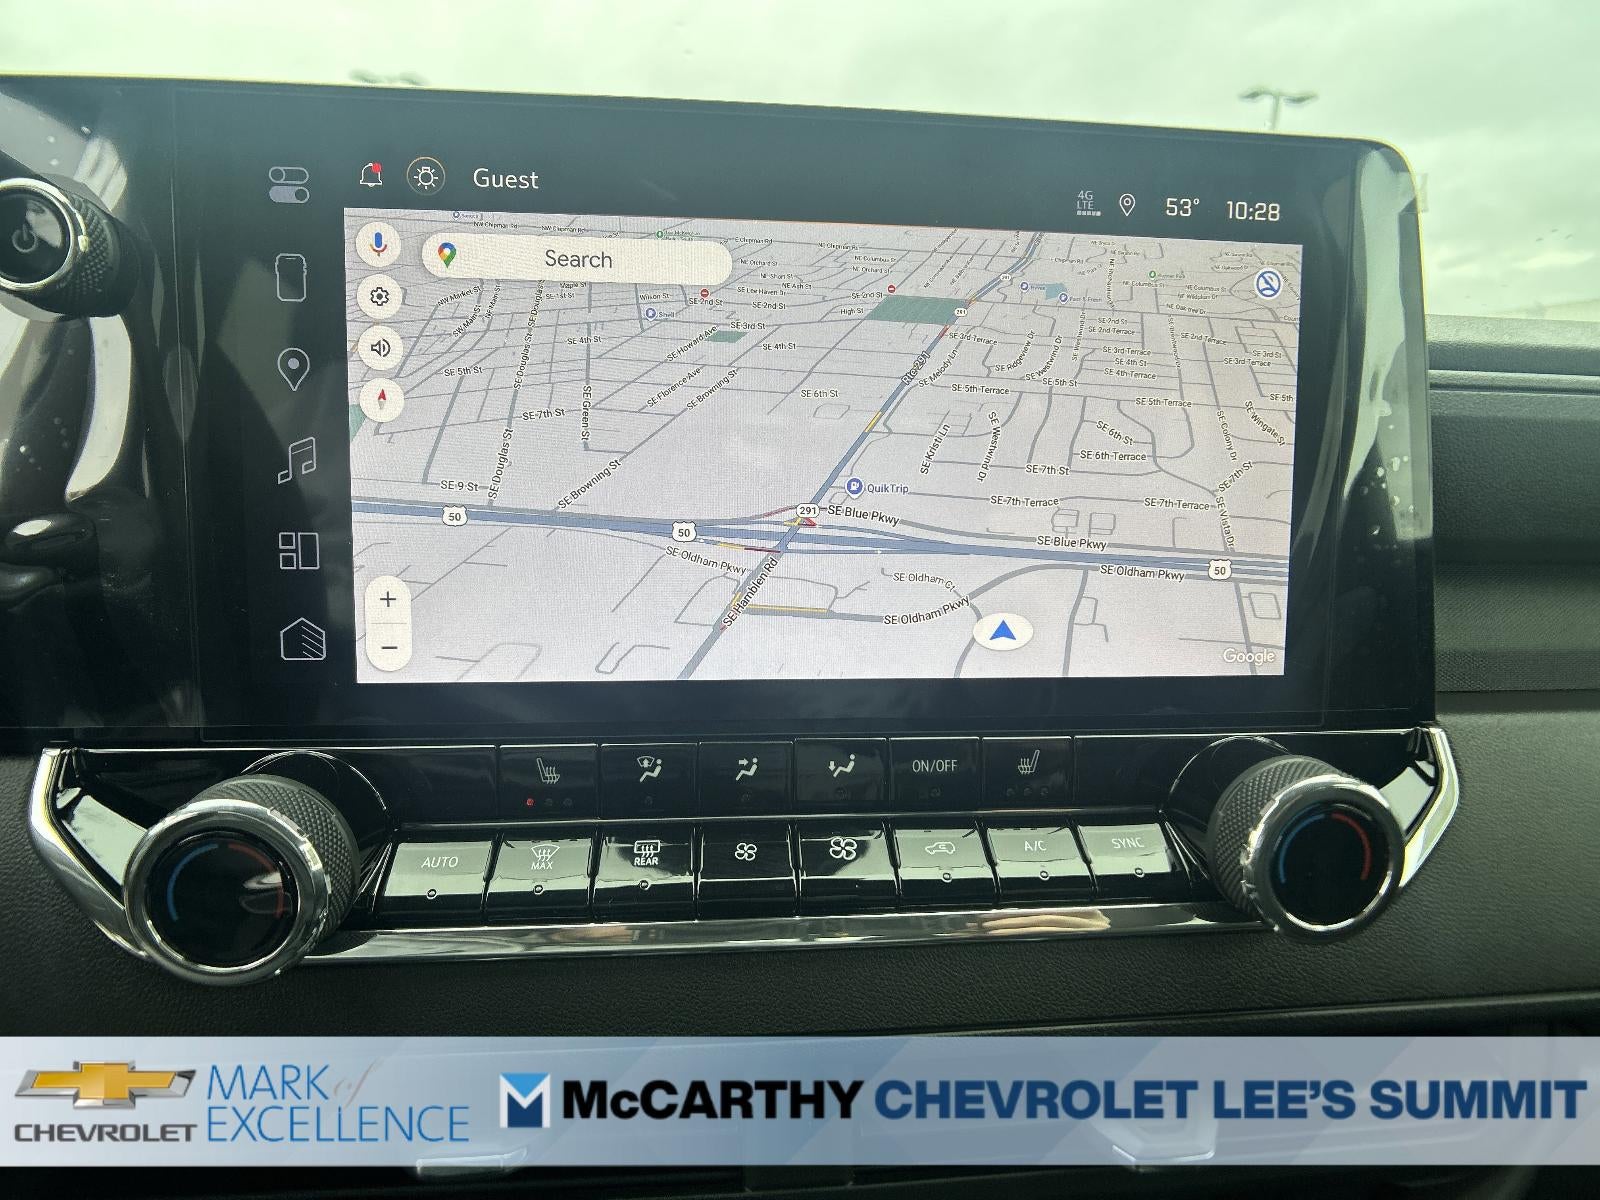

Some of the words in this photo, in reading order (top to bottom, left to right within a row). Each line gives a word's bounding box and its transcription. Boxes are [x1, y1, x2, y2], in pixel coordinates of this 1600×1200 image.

[473, 168, 539, 189] Guest
[1078, 191, 1093, 199] 4G
[1077, 201, 1093, 209] LTE
[1166, 198, 1199, 216] 53°
[1227, 201, 1280, 221] 10:28
[545, 249, 613, 269] Search
[525, 332, 533, 342] St
[667, 351, 678, 361] SE
[677, 335, 703, 355] Howard
[703, 325, 717, 338] Ave
[960, 333, 970, 341] 3rd
[972, 335, 997, 345] Terrace
[1007, 341, 1031, 371] Ridgeview
[1027, 330, 1035, 340] Dr
[517, 344, 530, 376] Douglas
[1026, 373, 1036, 381] SE
[1036, 344, 1060, 378] Westwind
[1055, 335, 1062, 344] Dr
[473, 366, 482, 374] St
[918, 377, 930, 387] SE
[930, 357, 953, 382] Melody
[951, 349, 958, 359] Ln
[1130, 370, 1156, 379] Terrace
[514, 377, 523, 389] SE
[647, 397, 658, 407] SE
[657, 378, 687, 400] Florence
[687, 368, 701, 380] Ave
[686, 399, 697, 410] SE
[697, 376, 729, 402] Browning
[728, 369, 737, 379] St
[952, 384, 962, 392] SE
[964, 385, 977, 393] 5th
[980, 387, 1009, 395] Terrace
[583, 385, 591, 399] SE
[522, 412, 535, 420] SE
[538, 410, 552, 419] 7th
[554, 408, 565, 416] St
[582, 401, 591, 427] Green
[988, 412, 999, 426] SE
[1245, 401, 1255, 414] SE
[1252, 414, 1278, 438] Wingate
[1276, 435, 1285, 446] St
[503, 429, 513, 440] St
[582, 431, 589, 440] St
[1096, 421, 1108, 431] SE
[1108, 428, 1122, 440] 6th
[1122, 435, 1134, 445] St
[1217, 411, 1225, 422] SE
[1221, 422, 1235, 452] Colony
[1230, 451, 1237, 460] Dr
[921, 462, 931, 474] SE
[928, 436, 943, 461] Kristi
[942, 424, 950, 437] Ln
[983, 427, 1000, 470] Westwind
[1080, 451, 1092, 459] SE
[1095, 452, 1110, 460] 6th
[492, 442, 510, 483] Douglas
[977, 472, 986, 482] Dr
[1026, 465, 1038, 473] SE
[1041, 465, 1056, 474] 7th
[1059, 467, 1069, 475] St
[1219, 481, 1230, 492] SE
[1228, 469, 1243, 484] 7th
[1242, 461, 1252, 471] St
[441, 480, 454, 489] SE
[458, 482, 463, 490] 9
[467, 483, 478, 491] St
[558, 497, 571, 509] SE
[571, 467, 611, 499] Browning
[609, 459, 621, 470] St
[867, 484, 908, 495] QuikTrip
[489, 485, 498, 499] SE
[991, 496, 1003, 504] SE
[1006, 497, 1020, 505] 7th
[1025, 498, 1059, 507] Terrace
[1145, 498, 1156, 506] SE
[1160, 499, 1173, 508] 7th
[1176, 501, 1209, 510] Terrace
[449, 513, 461, 521] 50
[800, 506, 816, 515] 291
[828, 506, 843, 515] SE
[845, 508, 868, 520] Blue
[871, 511, 899, 527] Pkwy
[1216, 496, 1225, 509] SE
[1221, 511, 1232, 536] Vista
[1228, 538, 1234, 547] Dr
[678, 529, 690, 537] 50
[1038, 536, 1051, 545] SE
[1054, 537, 1077, 547] Blue
[1079, 539, 1106, 551] Pkwy
[666, 546, 678, 556] SE
[680, 550, 718, 568] Oldham
[720, 560, 746, 575] Pkwy
[1101, 566, 1115, 574] SE
[1116, 567, 1155, 578] Oldham
[1158, 570, 1184, 582] Pkwy
[1215, 567, 1226, 575] 50
[893, 573, 905, 581] SE
[908, 574, 944, 584] Oldham
[945, 581, 955, 592] Ct
[723, 612, 737, 626] SE
[735, 571, 768, 613] Hamblen
[764, 557, 778, 573] Rd
[884, 615, 898, 624] SE
[901, 608, 942, 624] Oldham
[942, 595, 969, 616] Pkwy
[1223, 648, 1275, 665] Google
[912, 760, 957, 772] ON/OFF
[1025, 841, 1046, 852] A/C
[1112, 838, 1144, 849] SYNC
[422, 856, 458, 868] AUTO
[531, 861, 553, 870] MAX
[634, 857, 658, 866] REAR
